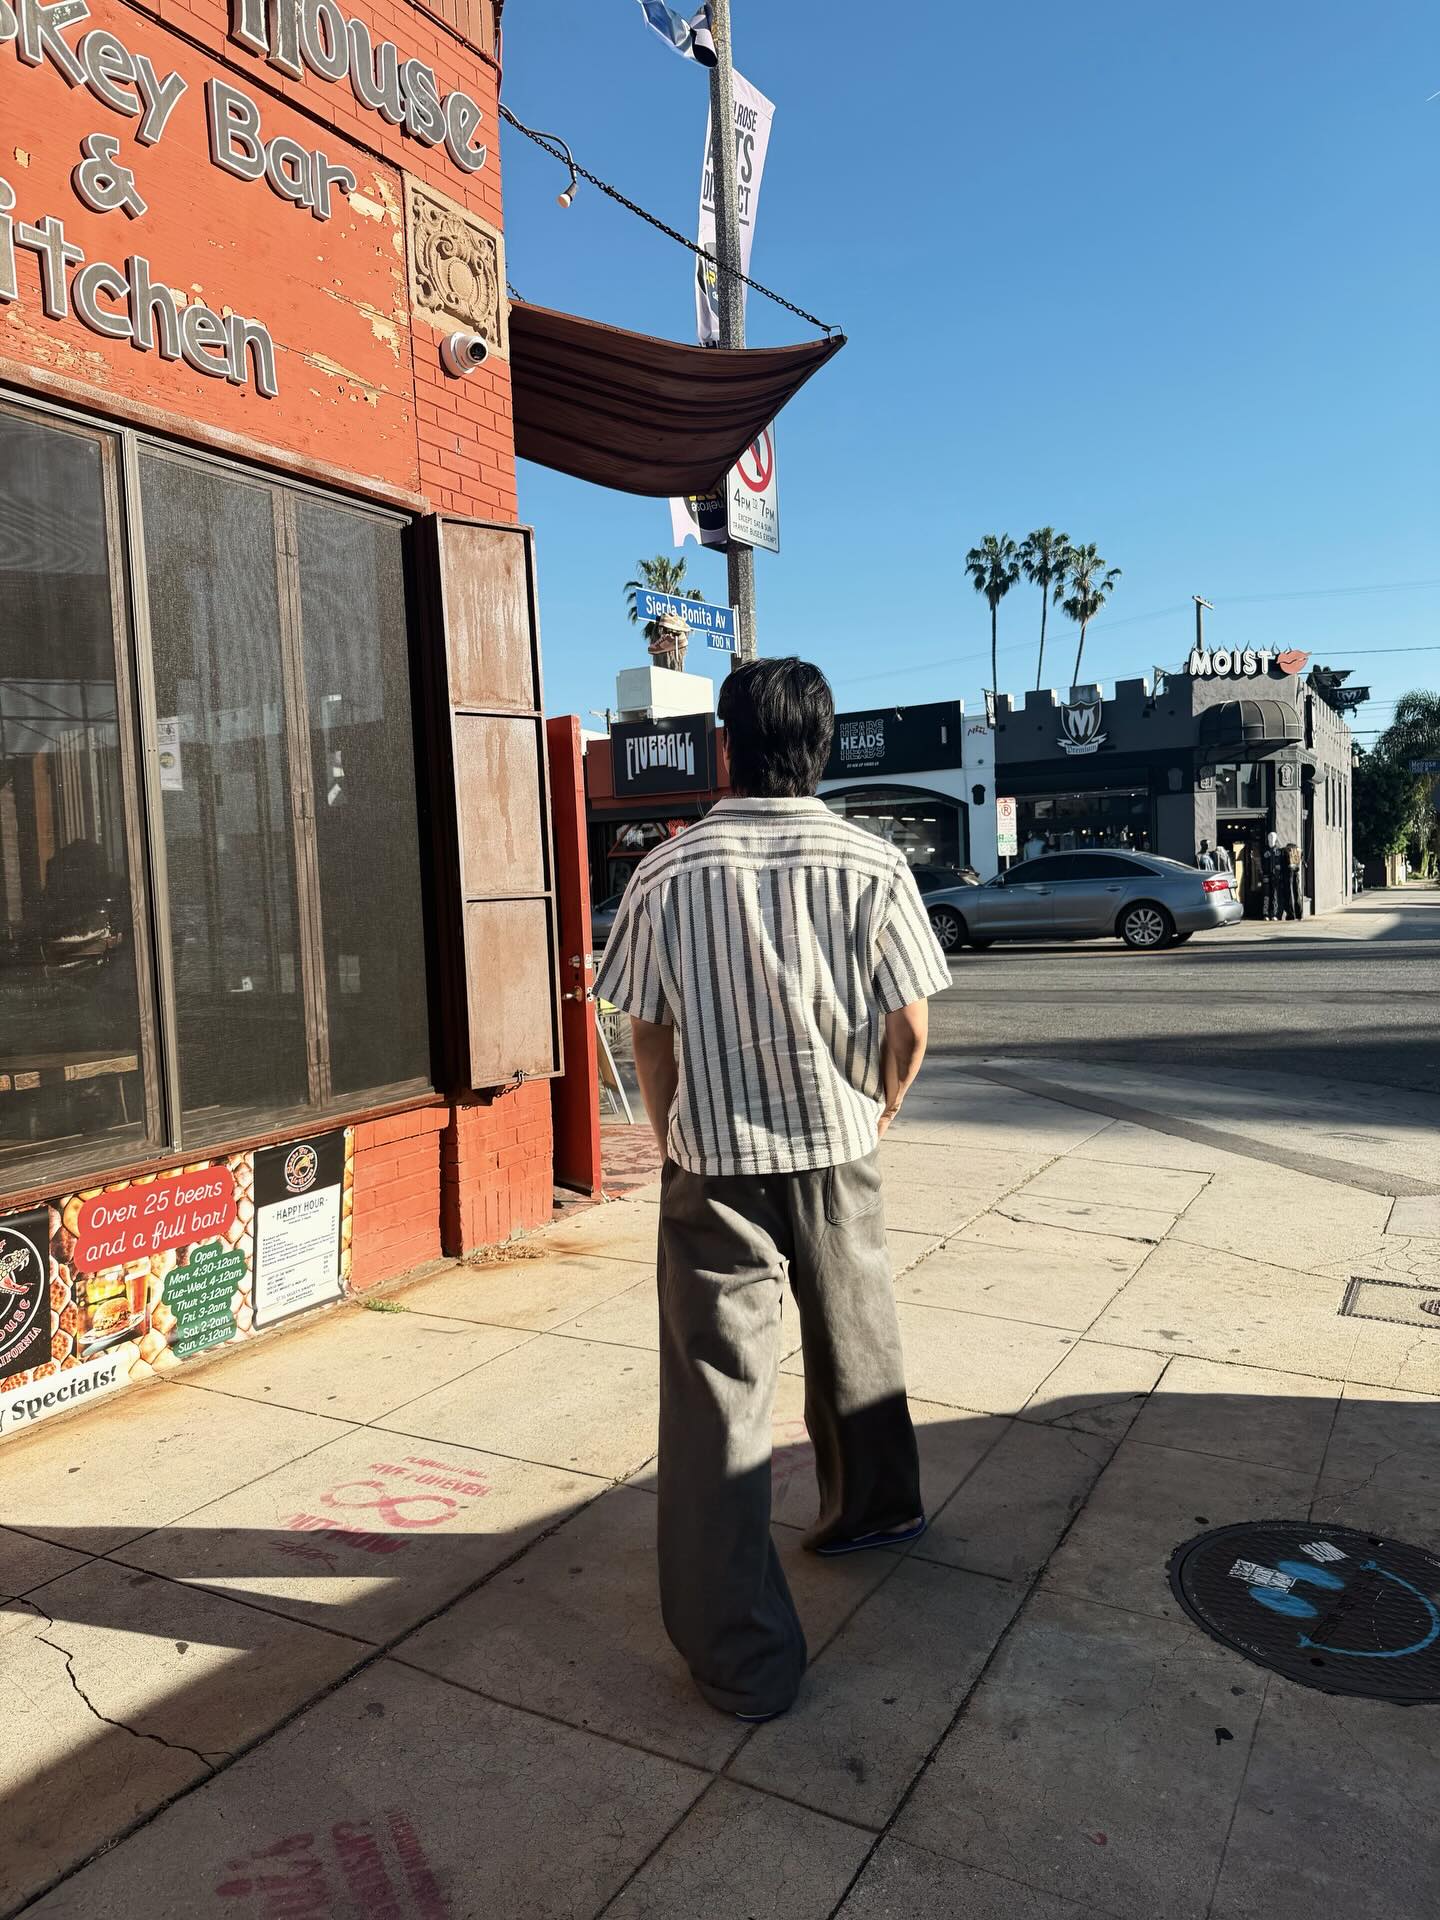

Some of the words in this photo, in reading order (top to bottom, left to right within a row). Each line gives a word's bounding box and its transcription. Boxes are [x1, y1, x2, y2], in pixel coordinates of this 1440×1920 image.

[0, 0, 188, 145] key
[208, 77, 356, 221] Bar
[74, 133, 147, 219] &
[733, 488, 751, 511] 4PM
[759, 498, 775, 522] 7PM
[680, 603, 712, 627] Bonita
[715, 610, 726, 629] Av
[711, 635, 724, 649] 700
[726, 637, 731, 650] N
[1189, 650, 1273, 676] MOIST
[841, 733, 885, 750] HEADS
[625, 732, 695, 780] FIVEBALL
[91, 1205, 137, 1229] Over
[143, 1190, 170, 1215] 25
[174, 1181, 223, 1207] beers
[276, 1203, 302, 1220] HAPPY
[303, 1197, 325, 1212] HOUR
[86, 1231, 126, 1262] and
[132, 1232, 146, 1249] a
[151, 1214, 187, 1250] full
[191, 1204, 228, 1232] bar!
[195, 1249, 218, 1265] Open
[169, 1272, 190, 1286] Mon
[192, 1256, 241, 1278] 4:30-12am
[167, 1278, 207, 1301] Tue-Wed
[209, 1268, 243, 1286] 4-12am
[200, 1286, 234, 1303] 3-12am
[181, 1311, 196, 1325] Fri
[198, 1301, 227, 1318] 3-2am
[178, 1339, 197, 1353] Sun
[198, 1327, 232, 1345] 2-12am
[183, 1325, 199, 1339] Sat
[200, 1315, 230, 1330] 2-2am
[12, 1365, 117, 1420] Specials!
